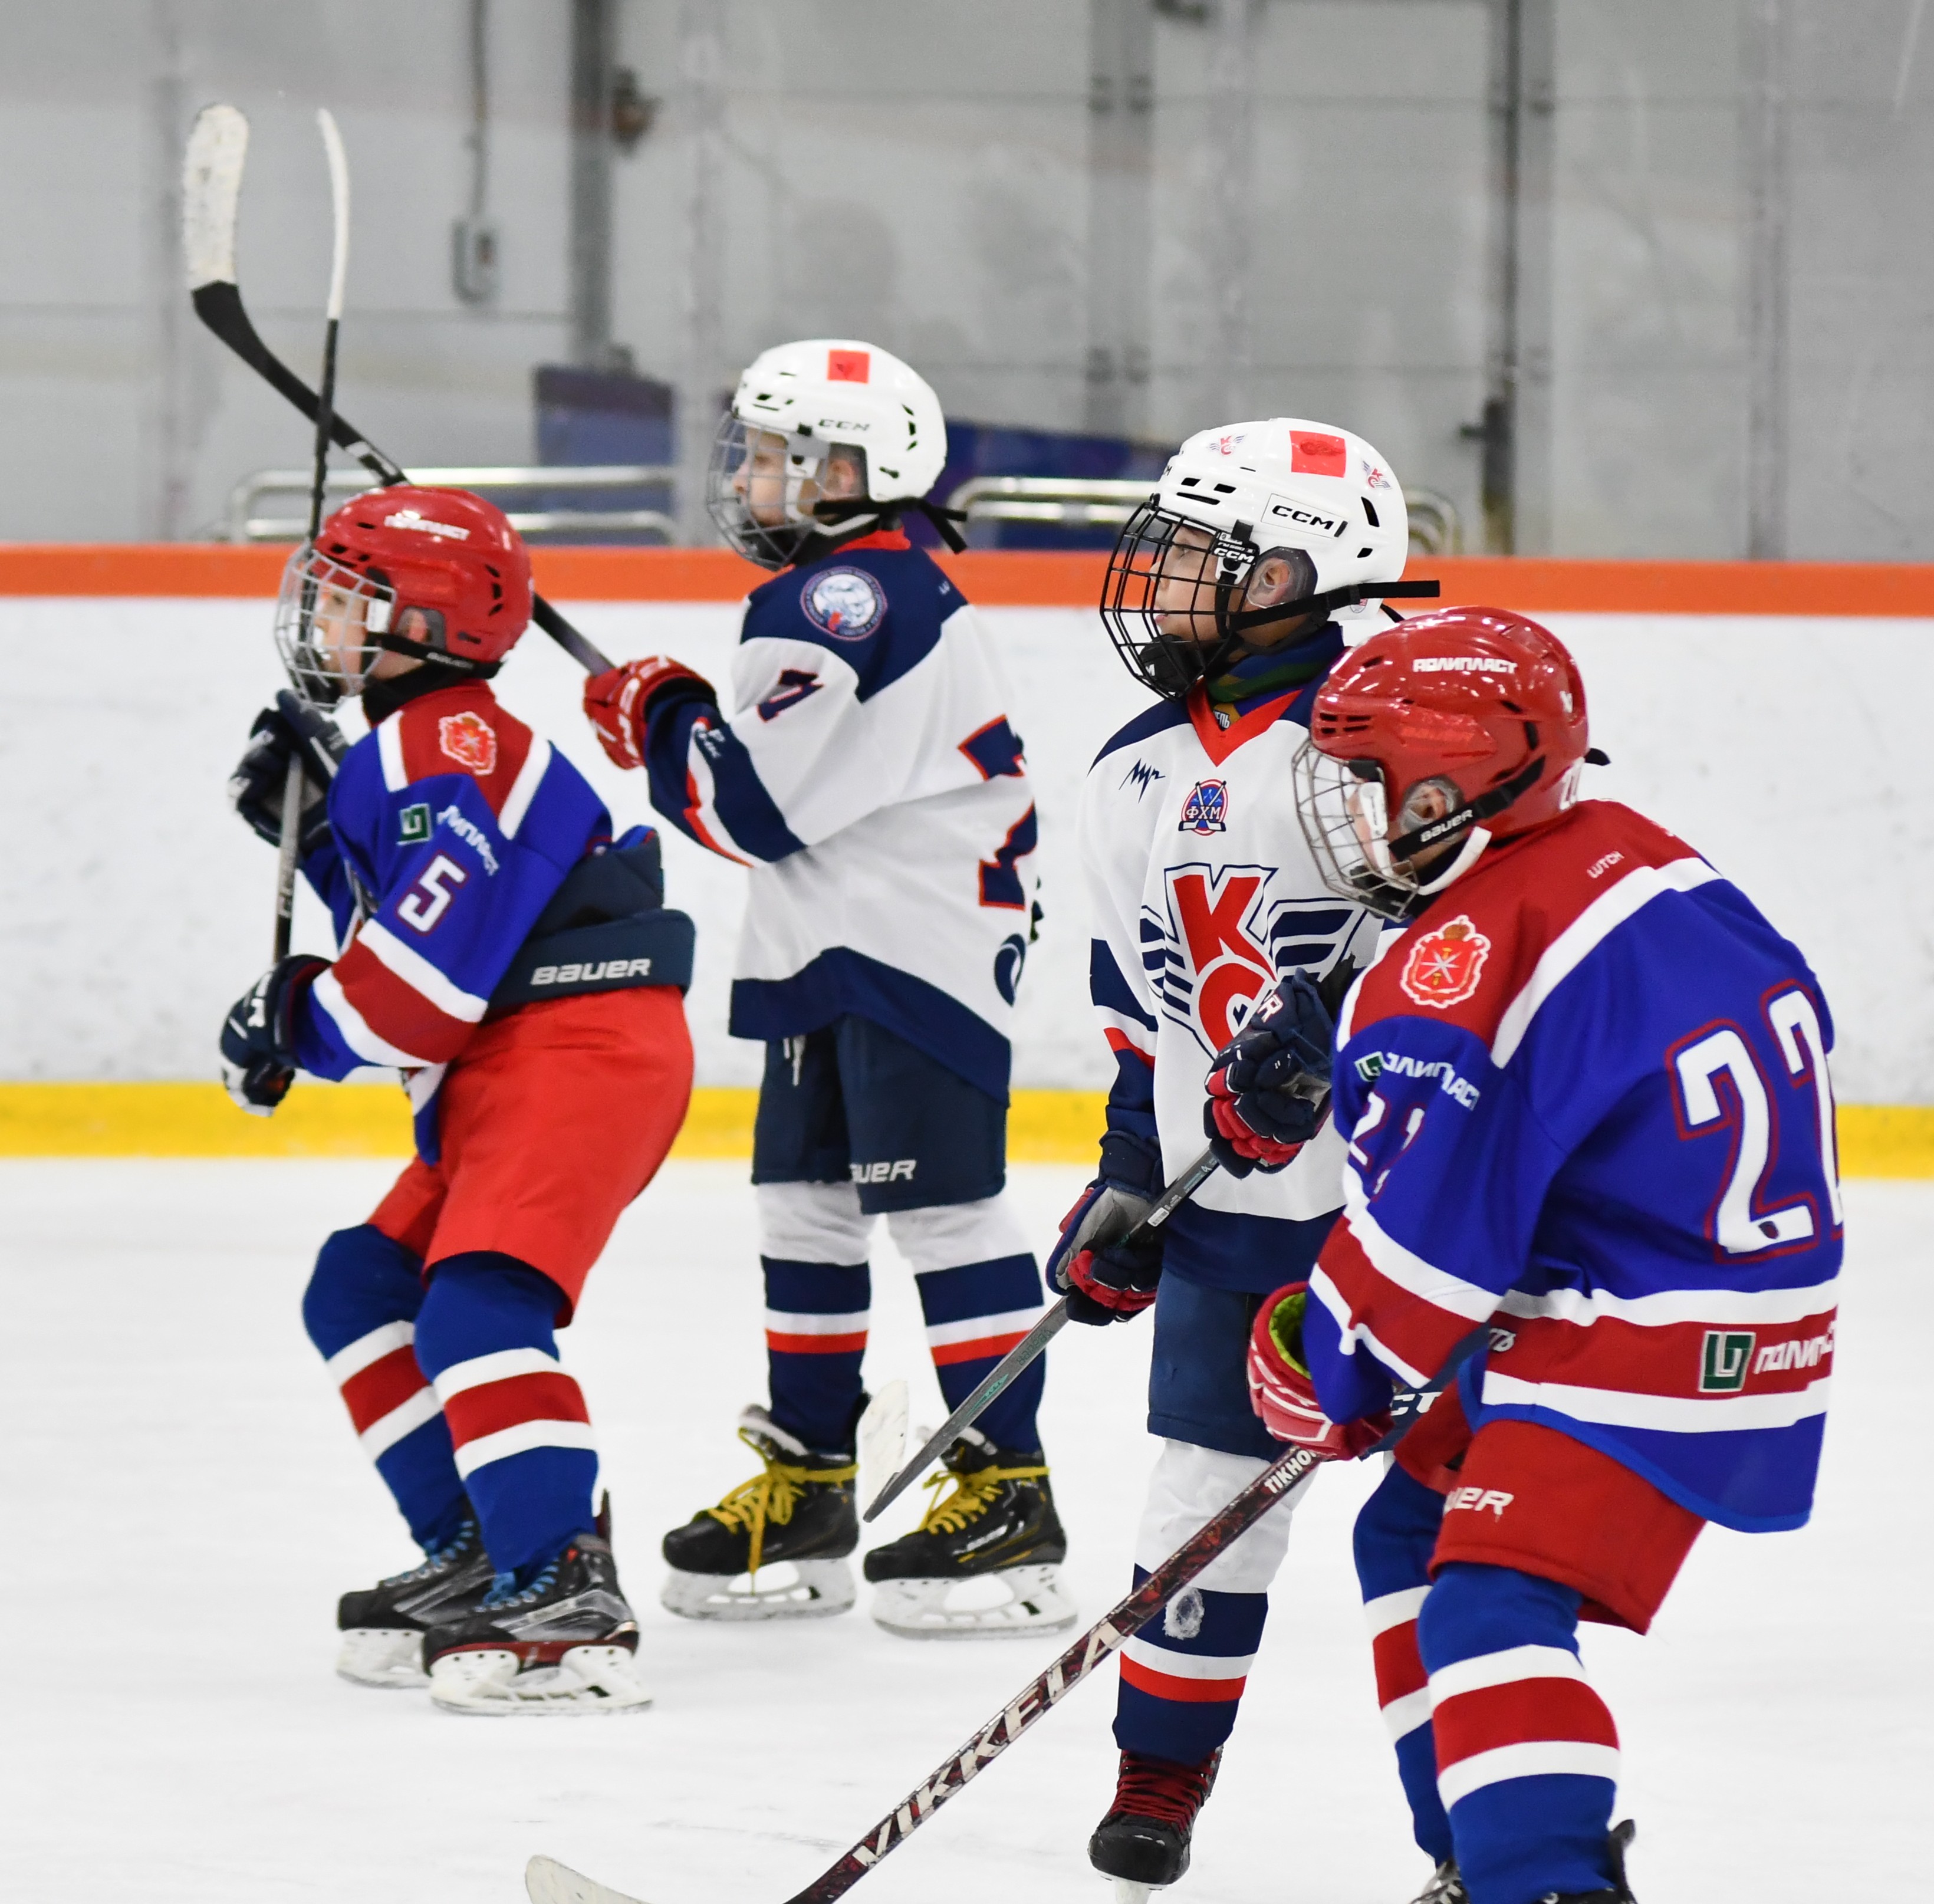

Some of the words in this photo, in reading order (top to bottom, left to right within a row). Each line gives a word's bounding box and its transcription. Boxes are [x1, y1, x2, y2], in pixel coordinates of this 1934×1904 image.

[1272, 505, 1334, 530] CCM
[1214, 547, 1255, 563] CCM
[1186, 805, 1221, 820] ФХМ
[397, 854, 467, 932] 5
[531, 958, 652, 985] BAUER
[853, 1622, 1127, 1867] VIKKELA
